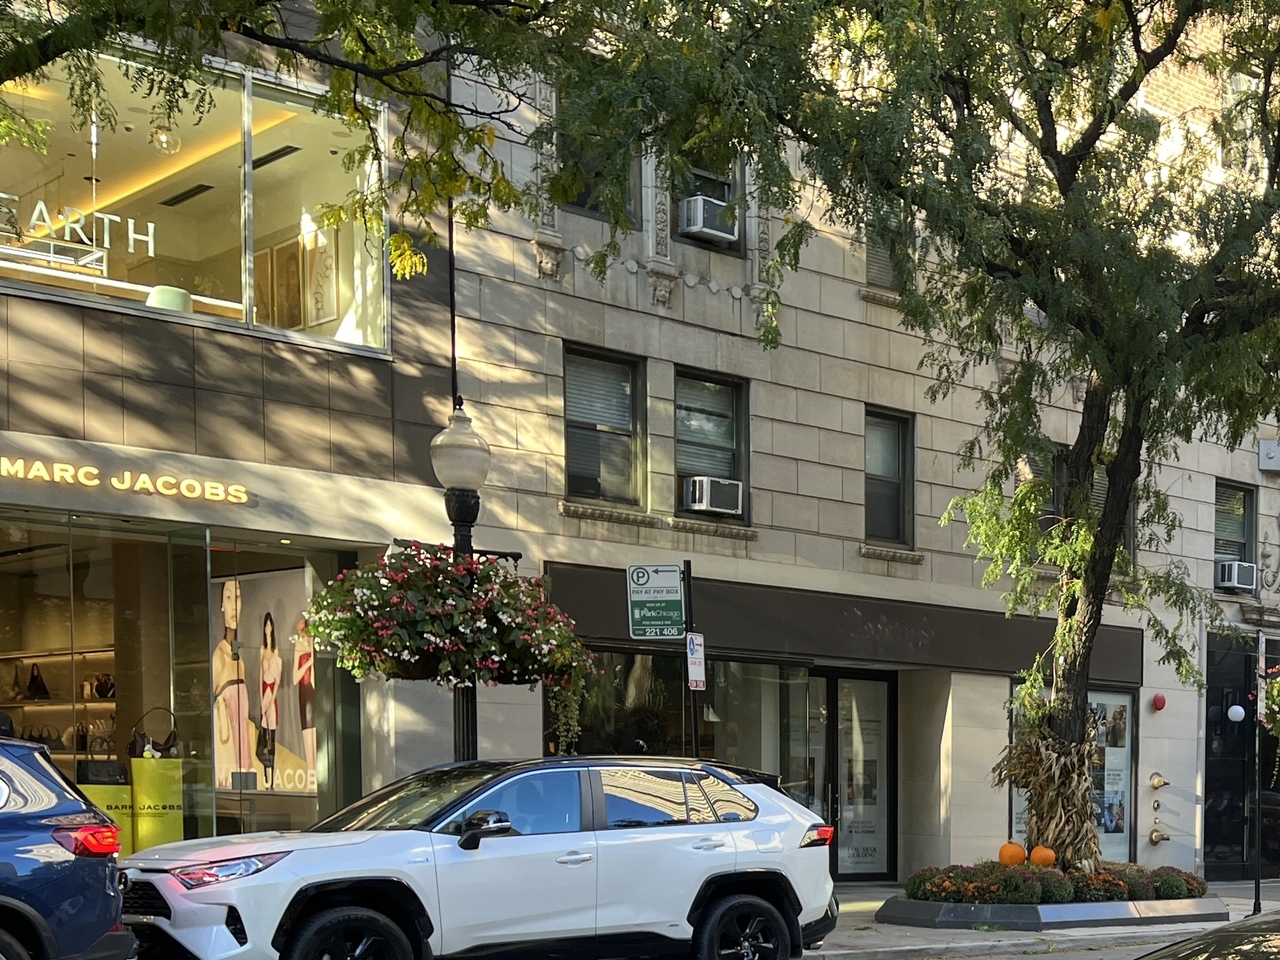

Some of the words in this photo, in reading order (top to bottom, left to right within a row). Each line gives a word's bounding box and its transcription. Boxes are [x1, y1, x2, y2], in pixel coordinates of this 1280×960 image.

[0, 457, 101, 487] MARC
[110, 470, 248, 504] JACOBS
[641, 608, 680, 618] ParkChicago
[662, 627, 678, 635] 406
